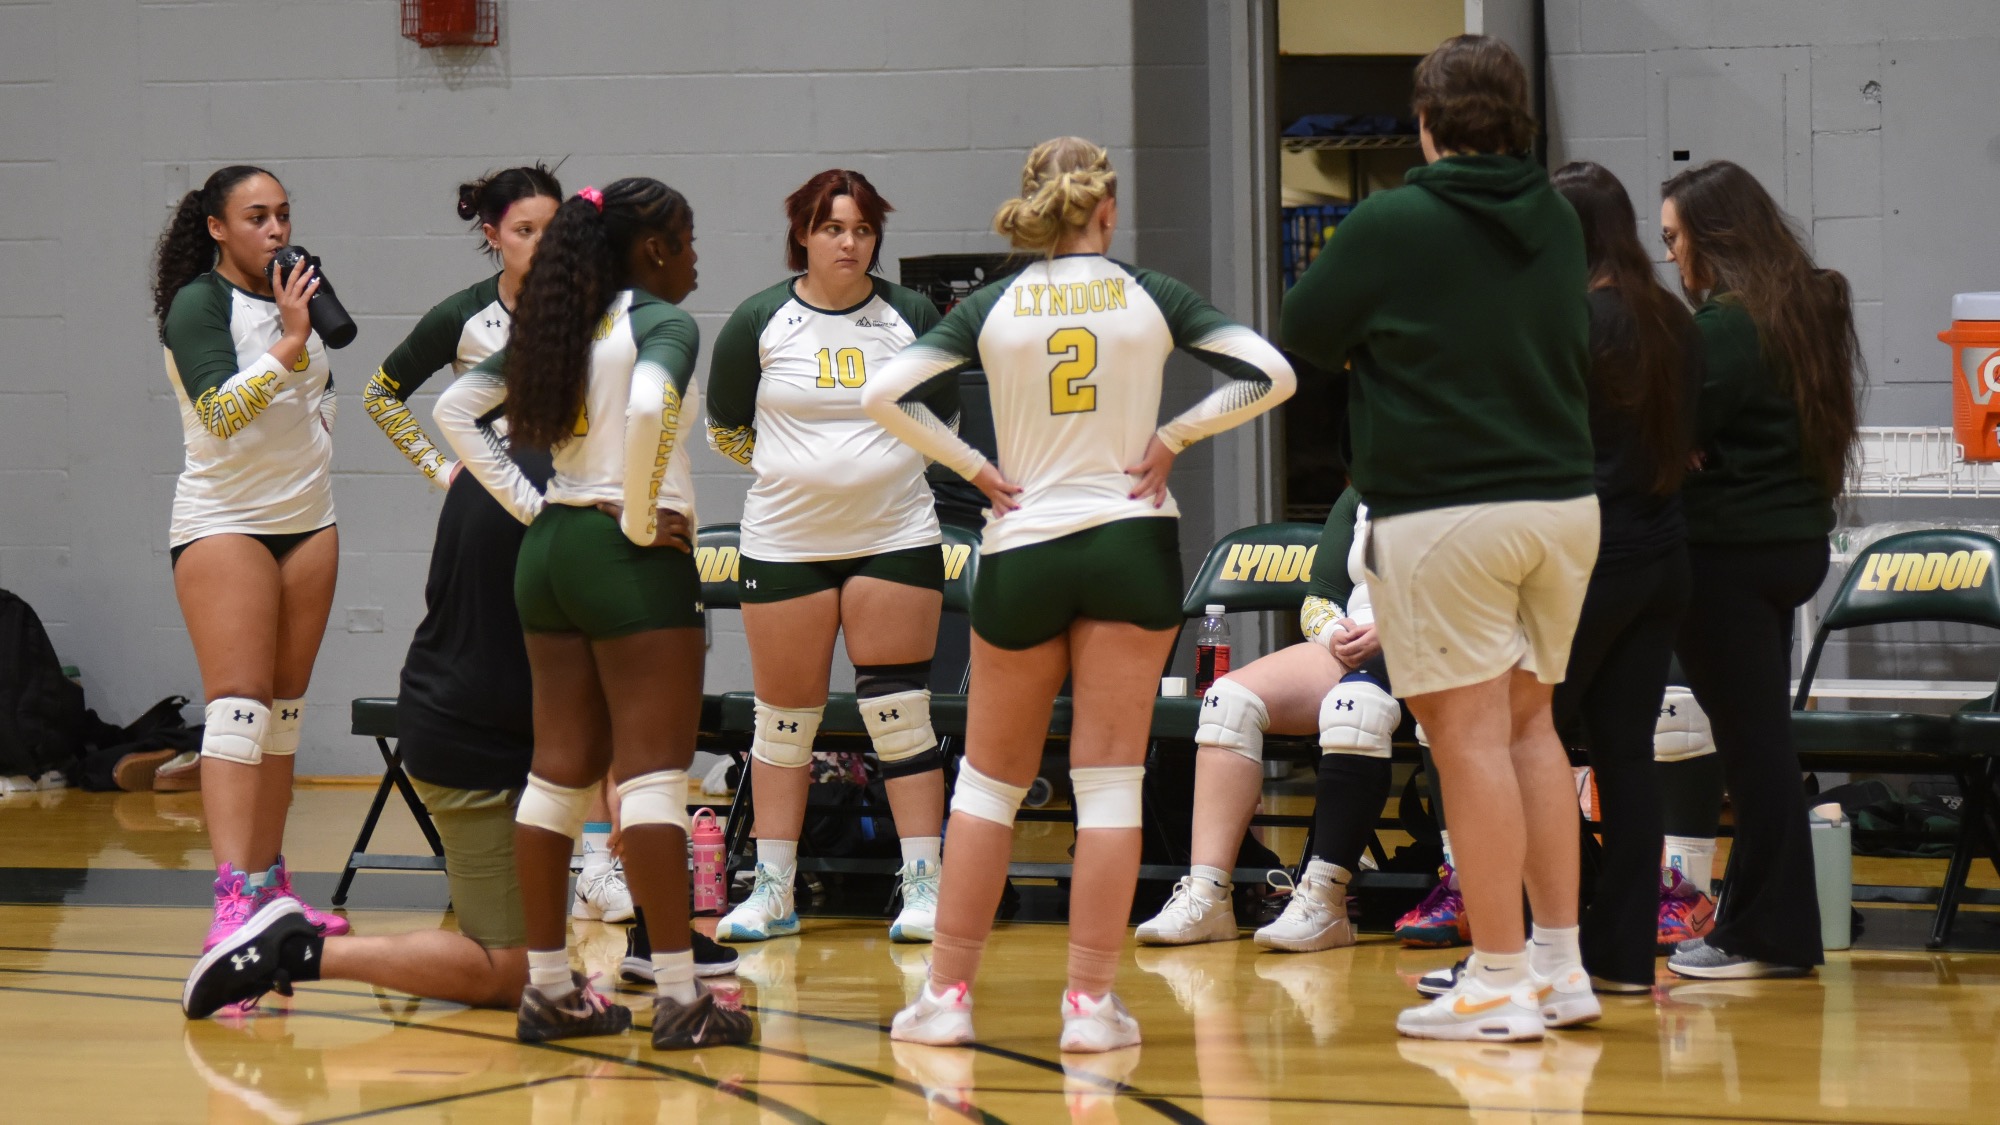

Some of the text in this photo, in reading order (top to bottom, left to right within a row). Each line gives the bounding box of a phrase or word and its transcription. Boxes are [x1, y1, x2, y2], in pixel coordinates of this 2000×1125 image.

[1014, 278, 1127, 317] LYNDON
[814, 347, 866, 388] 10
[1047, 326, 1097, 416] 2
[1857, 549, 1993, 592] LYNDON
